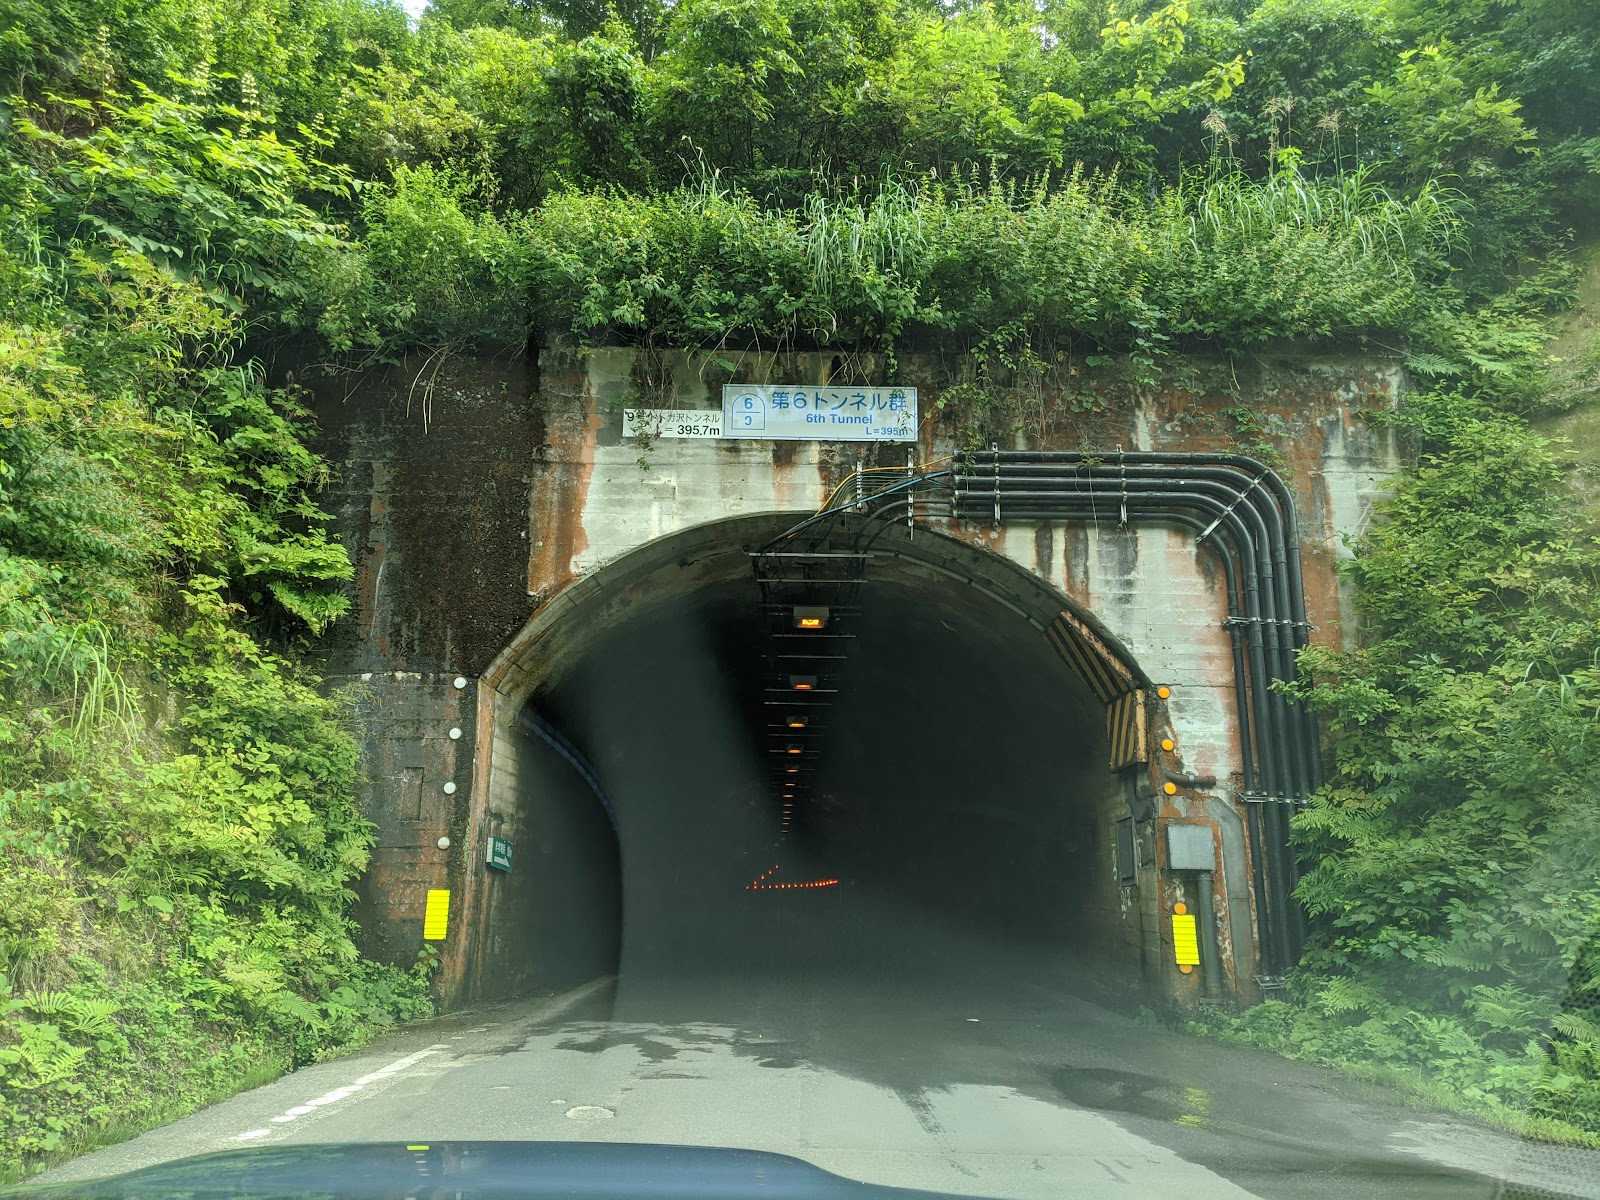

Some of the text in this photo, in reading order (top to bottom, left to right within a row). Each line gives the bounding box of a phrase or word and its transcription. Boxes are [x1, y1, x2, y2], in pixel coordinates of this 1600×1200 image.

[744, 397, 753, 409] 6
[772, 391, 906, 411] 第6トンネル群
[806, 413, 873, 425] 6th Tunnel
[677, 424, 720, 436] 395.7m
[865, 427, 908, 436] L=395m
